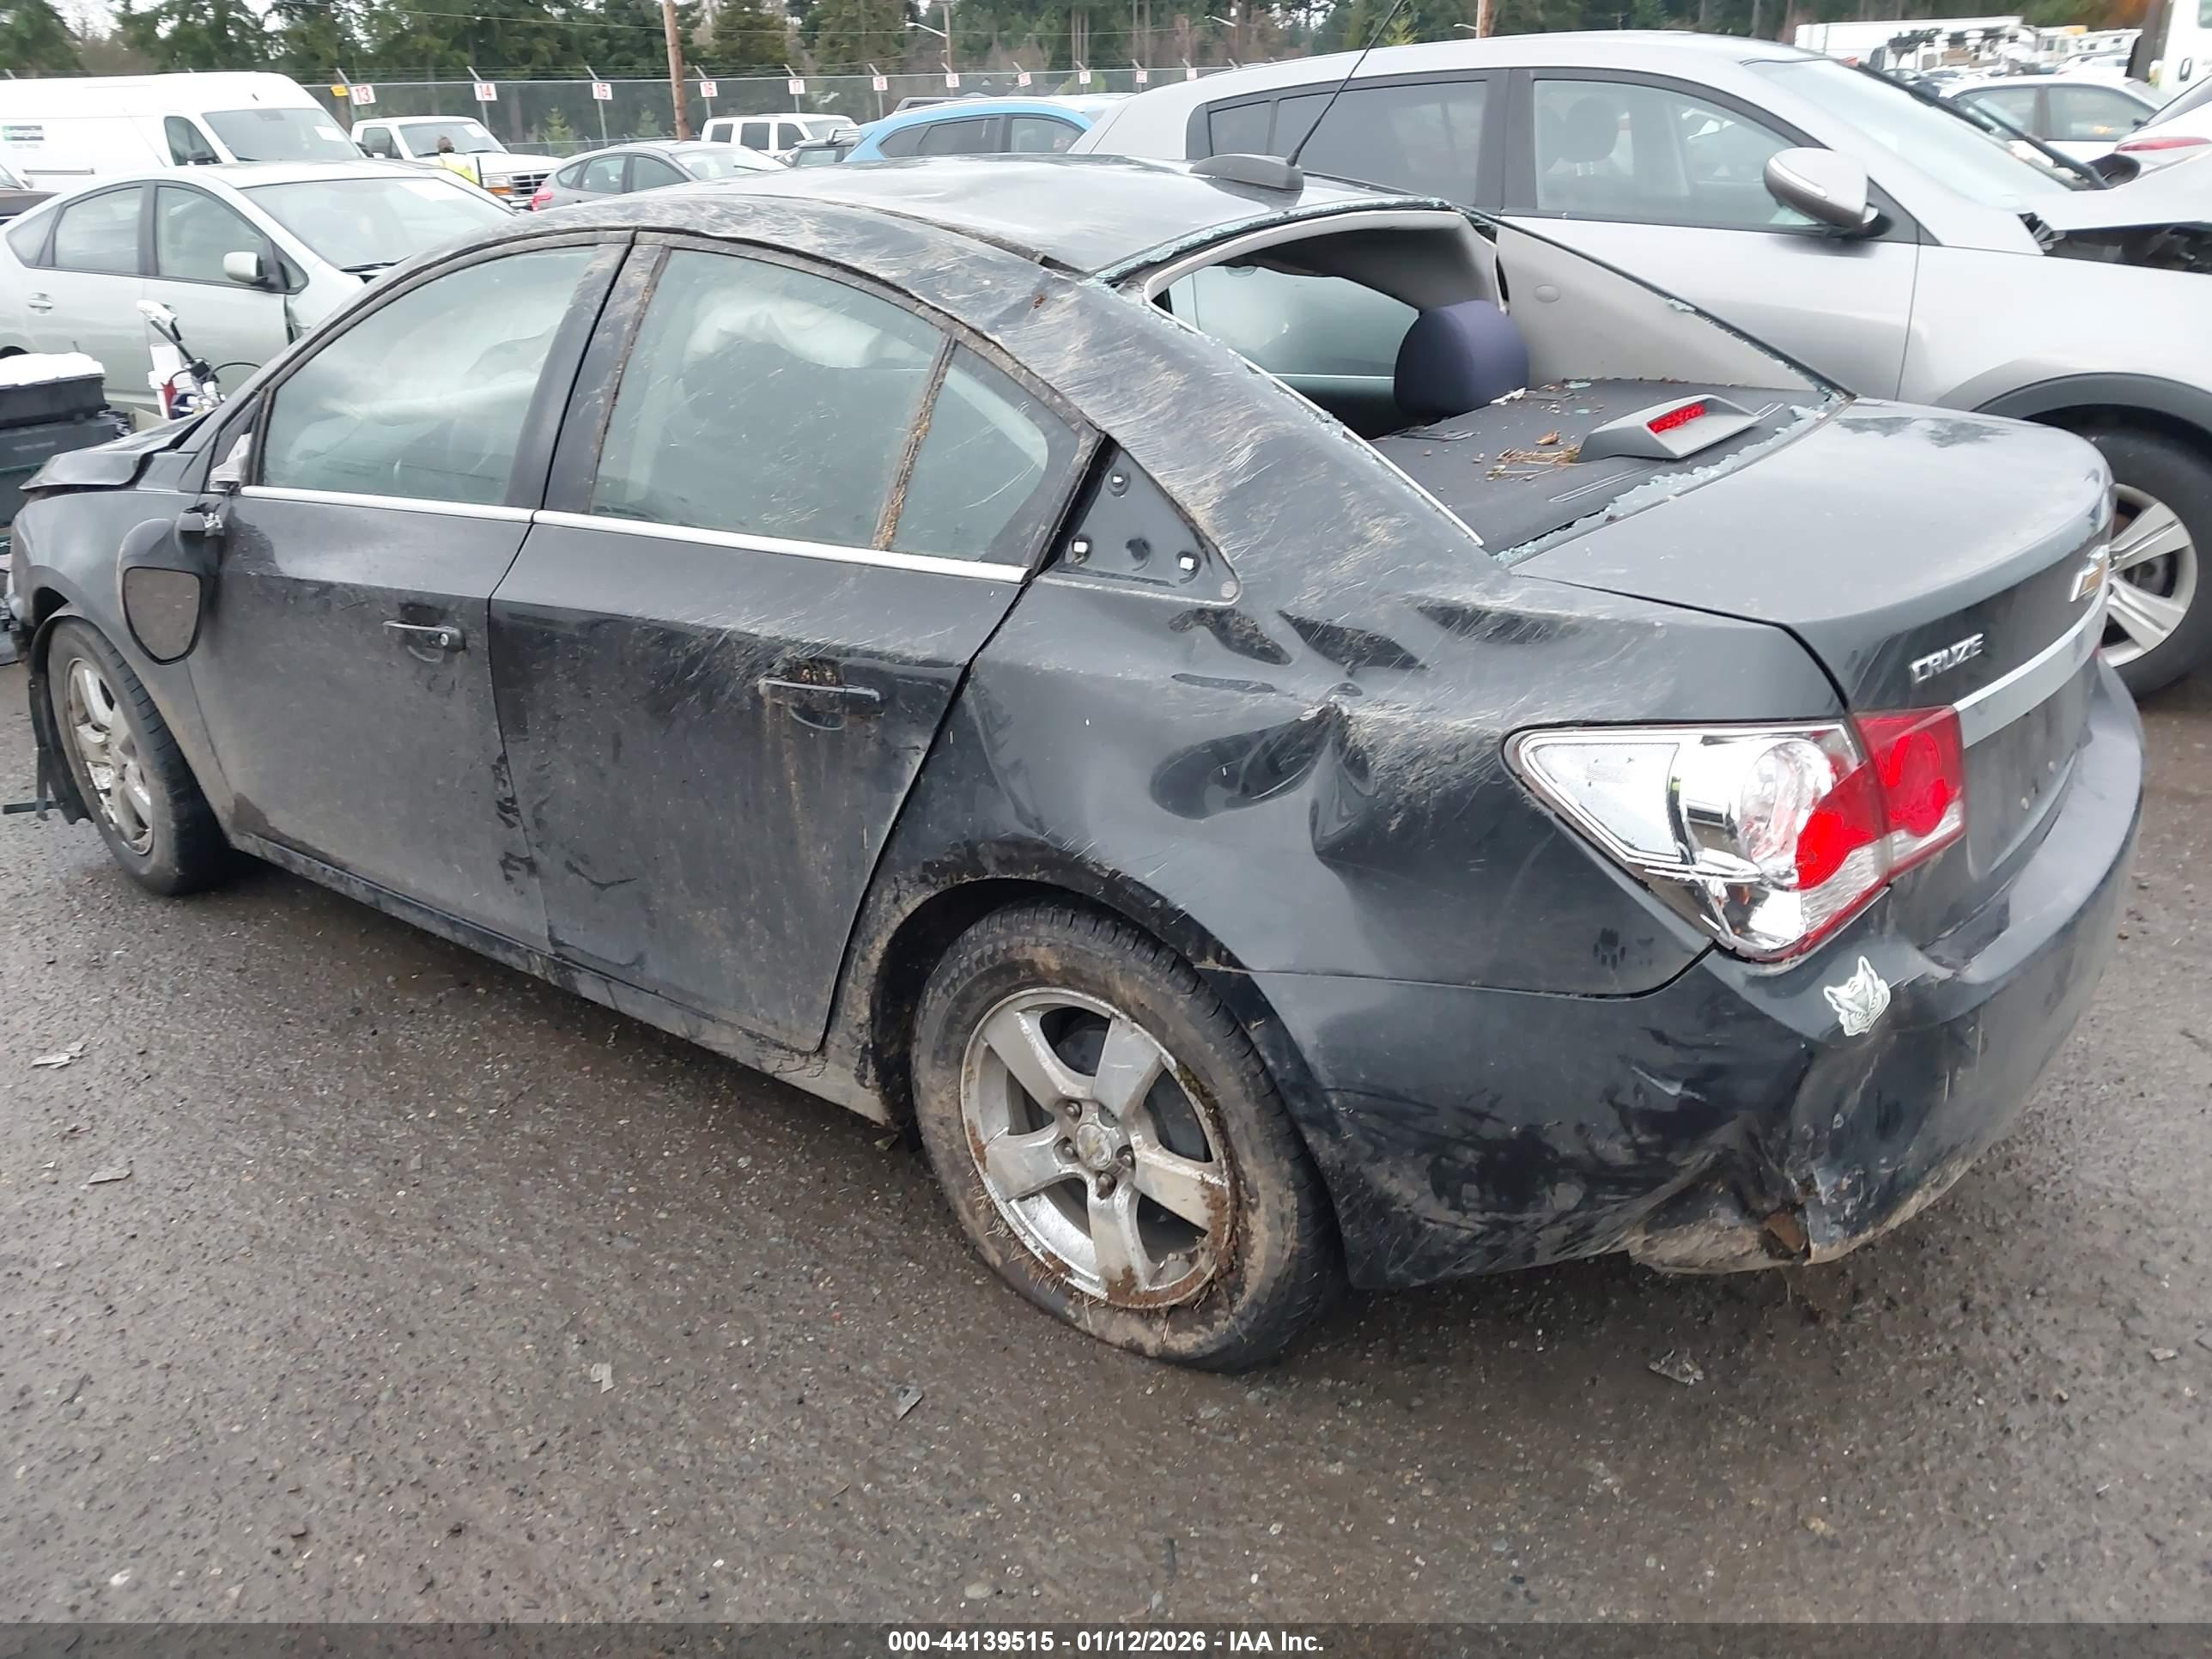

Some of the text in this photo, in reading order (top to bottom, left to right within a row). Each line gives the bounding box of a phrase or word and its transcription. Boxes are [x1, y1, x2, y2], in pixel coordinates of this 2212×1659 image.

[479, 85, 492, 99] 14
[596, 84, 608, 98] 15
[793, 81, 800, 92] 17
[356, 87, 371, 102] 13
[1909, 634, 1984, 684] CRUZE
